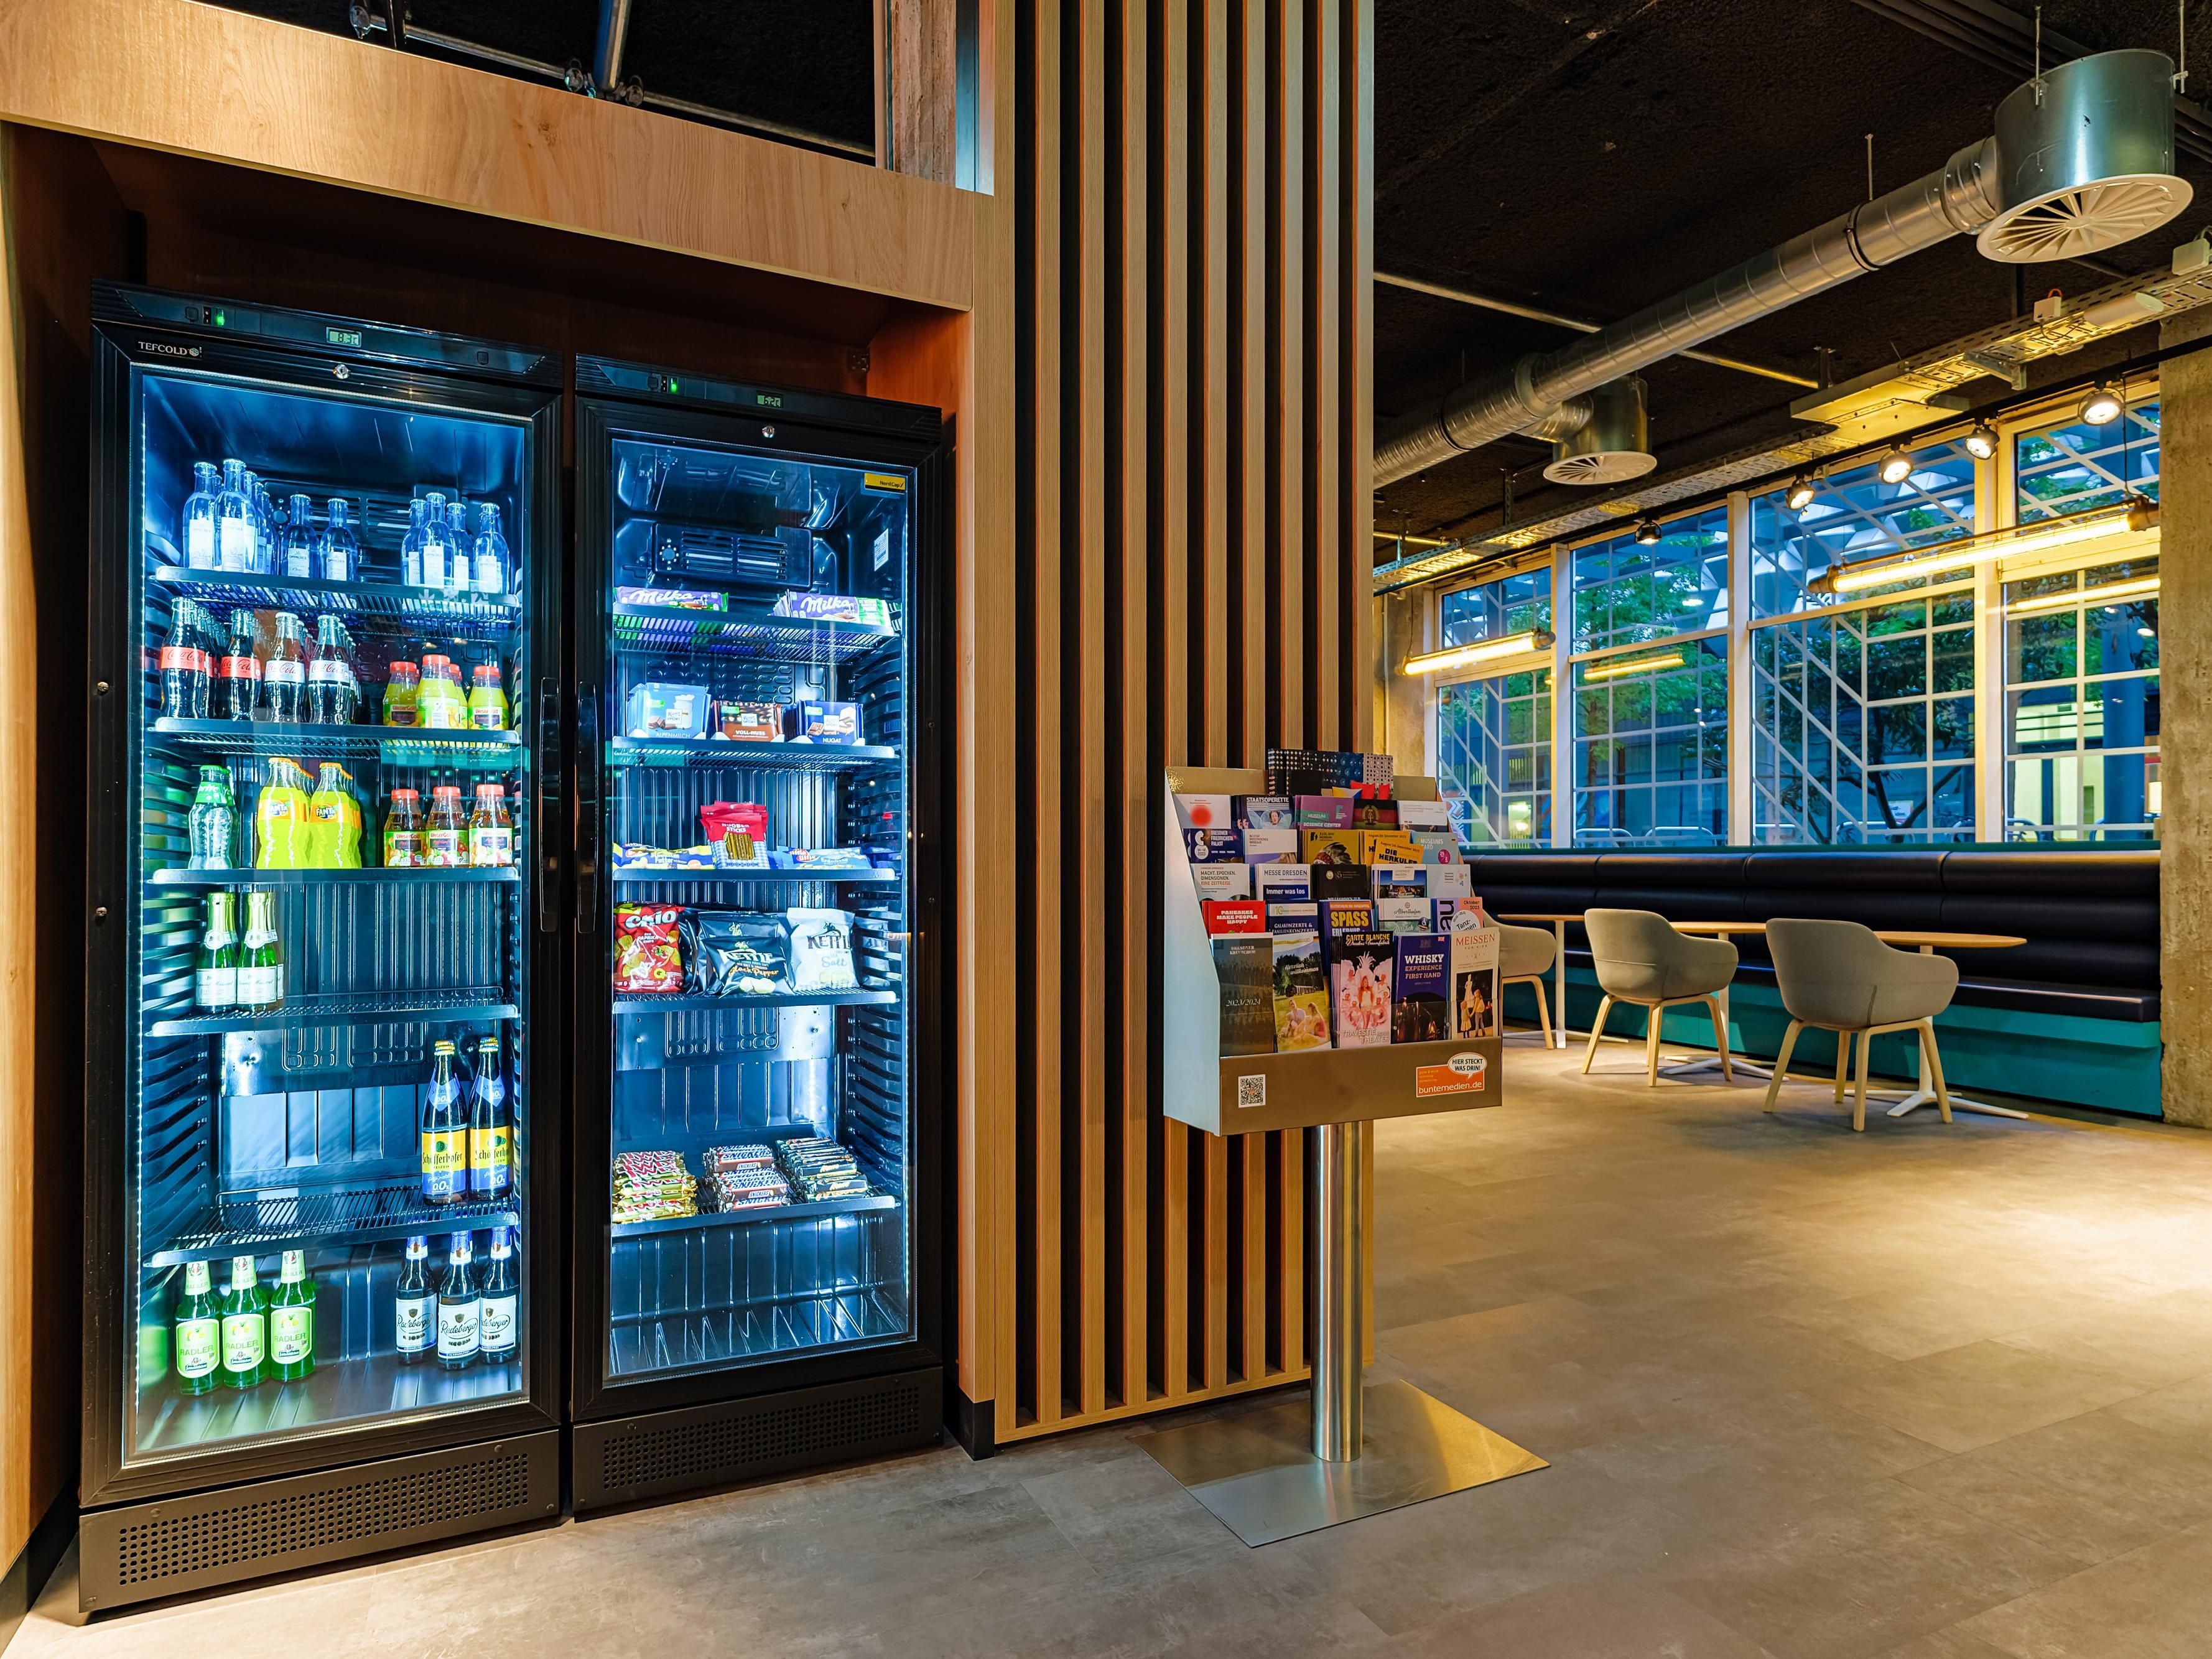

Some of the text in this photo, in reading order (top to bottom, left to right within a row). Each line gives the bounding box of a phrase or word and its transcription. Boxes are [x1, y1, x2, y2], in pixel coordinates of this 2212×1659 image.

[138, 342, 187, 356] TEFCOLD
[880, 480, 900, 488] NordCap
[629, 588, 696, 605] Milka
[800, 596, 851, 613] Milka
[316, 806, 336, 817] FANTA
[1385, 848, 1398, 856] DIE
[1331, 911, 1369, 927] SPASS
[806, 933, 850, 949] KETTL
[1456, 933, 1495, 946] MEISSEN
[717, 949, 776, 965] KETTLE
[821, 956, 847, 967] Salt
[1404, 954, 1444, 964] WHISKY
[752, 967, 779, 977] Pepper
[1290, 967, 1319, 975] willkommen
[1225, 998, 1261, 1006] 2023/2024
[1341, 1028, 1377, 1037] TRAVESTIE
[1360, 1035, 1389, 1044] THEATER
[1418, 1081, 1482, 1094] buntemedien.de
[422, 1151, 463, 1165] Schfferhofer
[440, 1319, 478, 1336] Radeberger
[481, 1314, 510, 1330] deberger
[274, 1332, 306, 1342] RADLER
[180, 1344, 214, 1356] RADLER
[226, 1339, 259, 1350] RADLER
